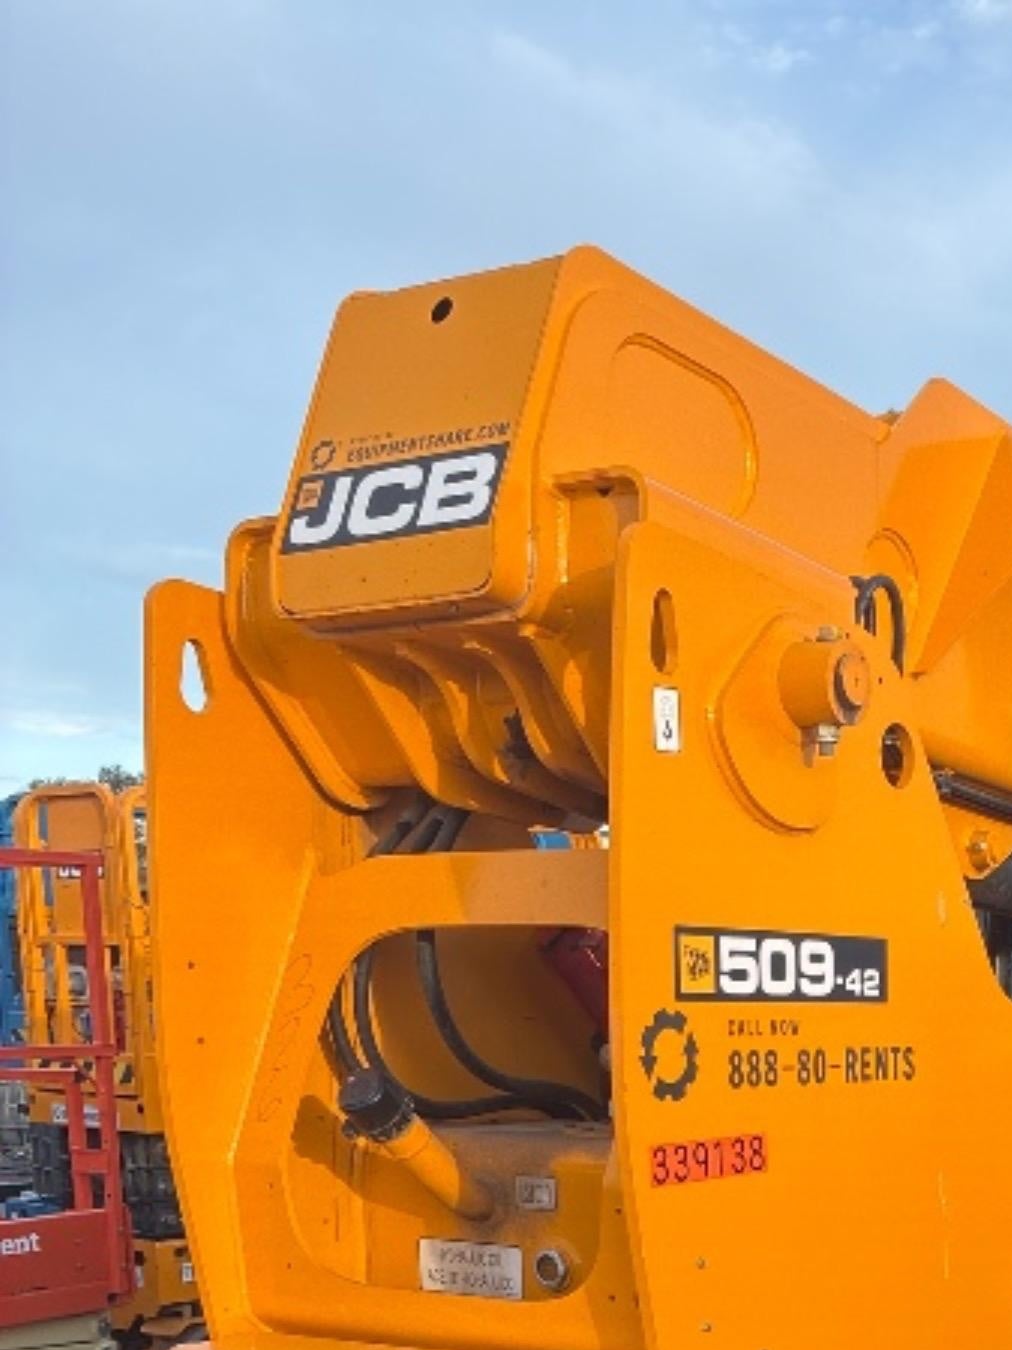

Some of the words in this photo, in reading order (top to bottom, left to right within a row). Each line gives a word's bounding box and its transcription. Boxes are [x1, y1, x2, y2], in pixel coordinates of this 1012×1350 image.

[290, 452, 498, 545] JCB
[728, 1019, 764, 1037] CALL
[769, 1019, 800, 1037] NOW
[728, 1046, 917, 1090] 888-80-RENTS
[652, 1135, 767, 1186] 339138
